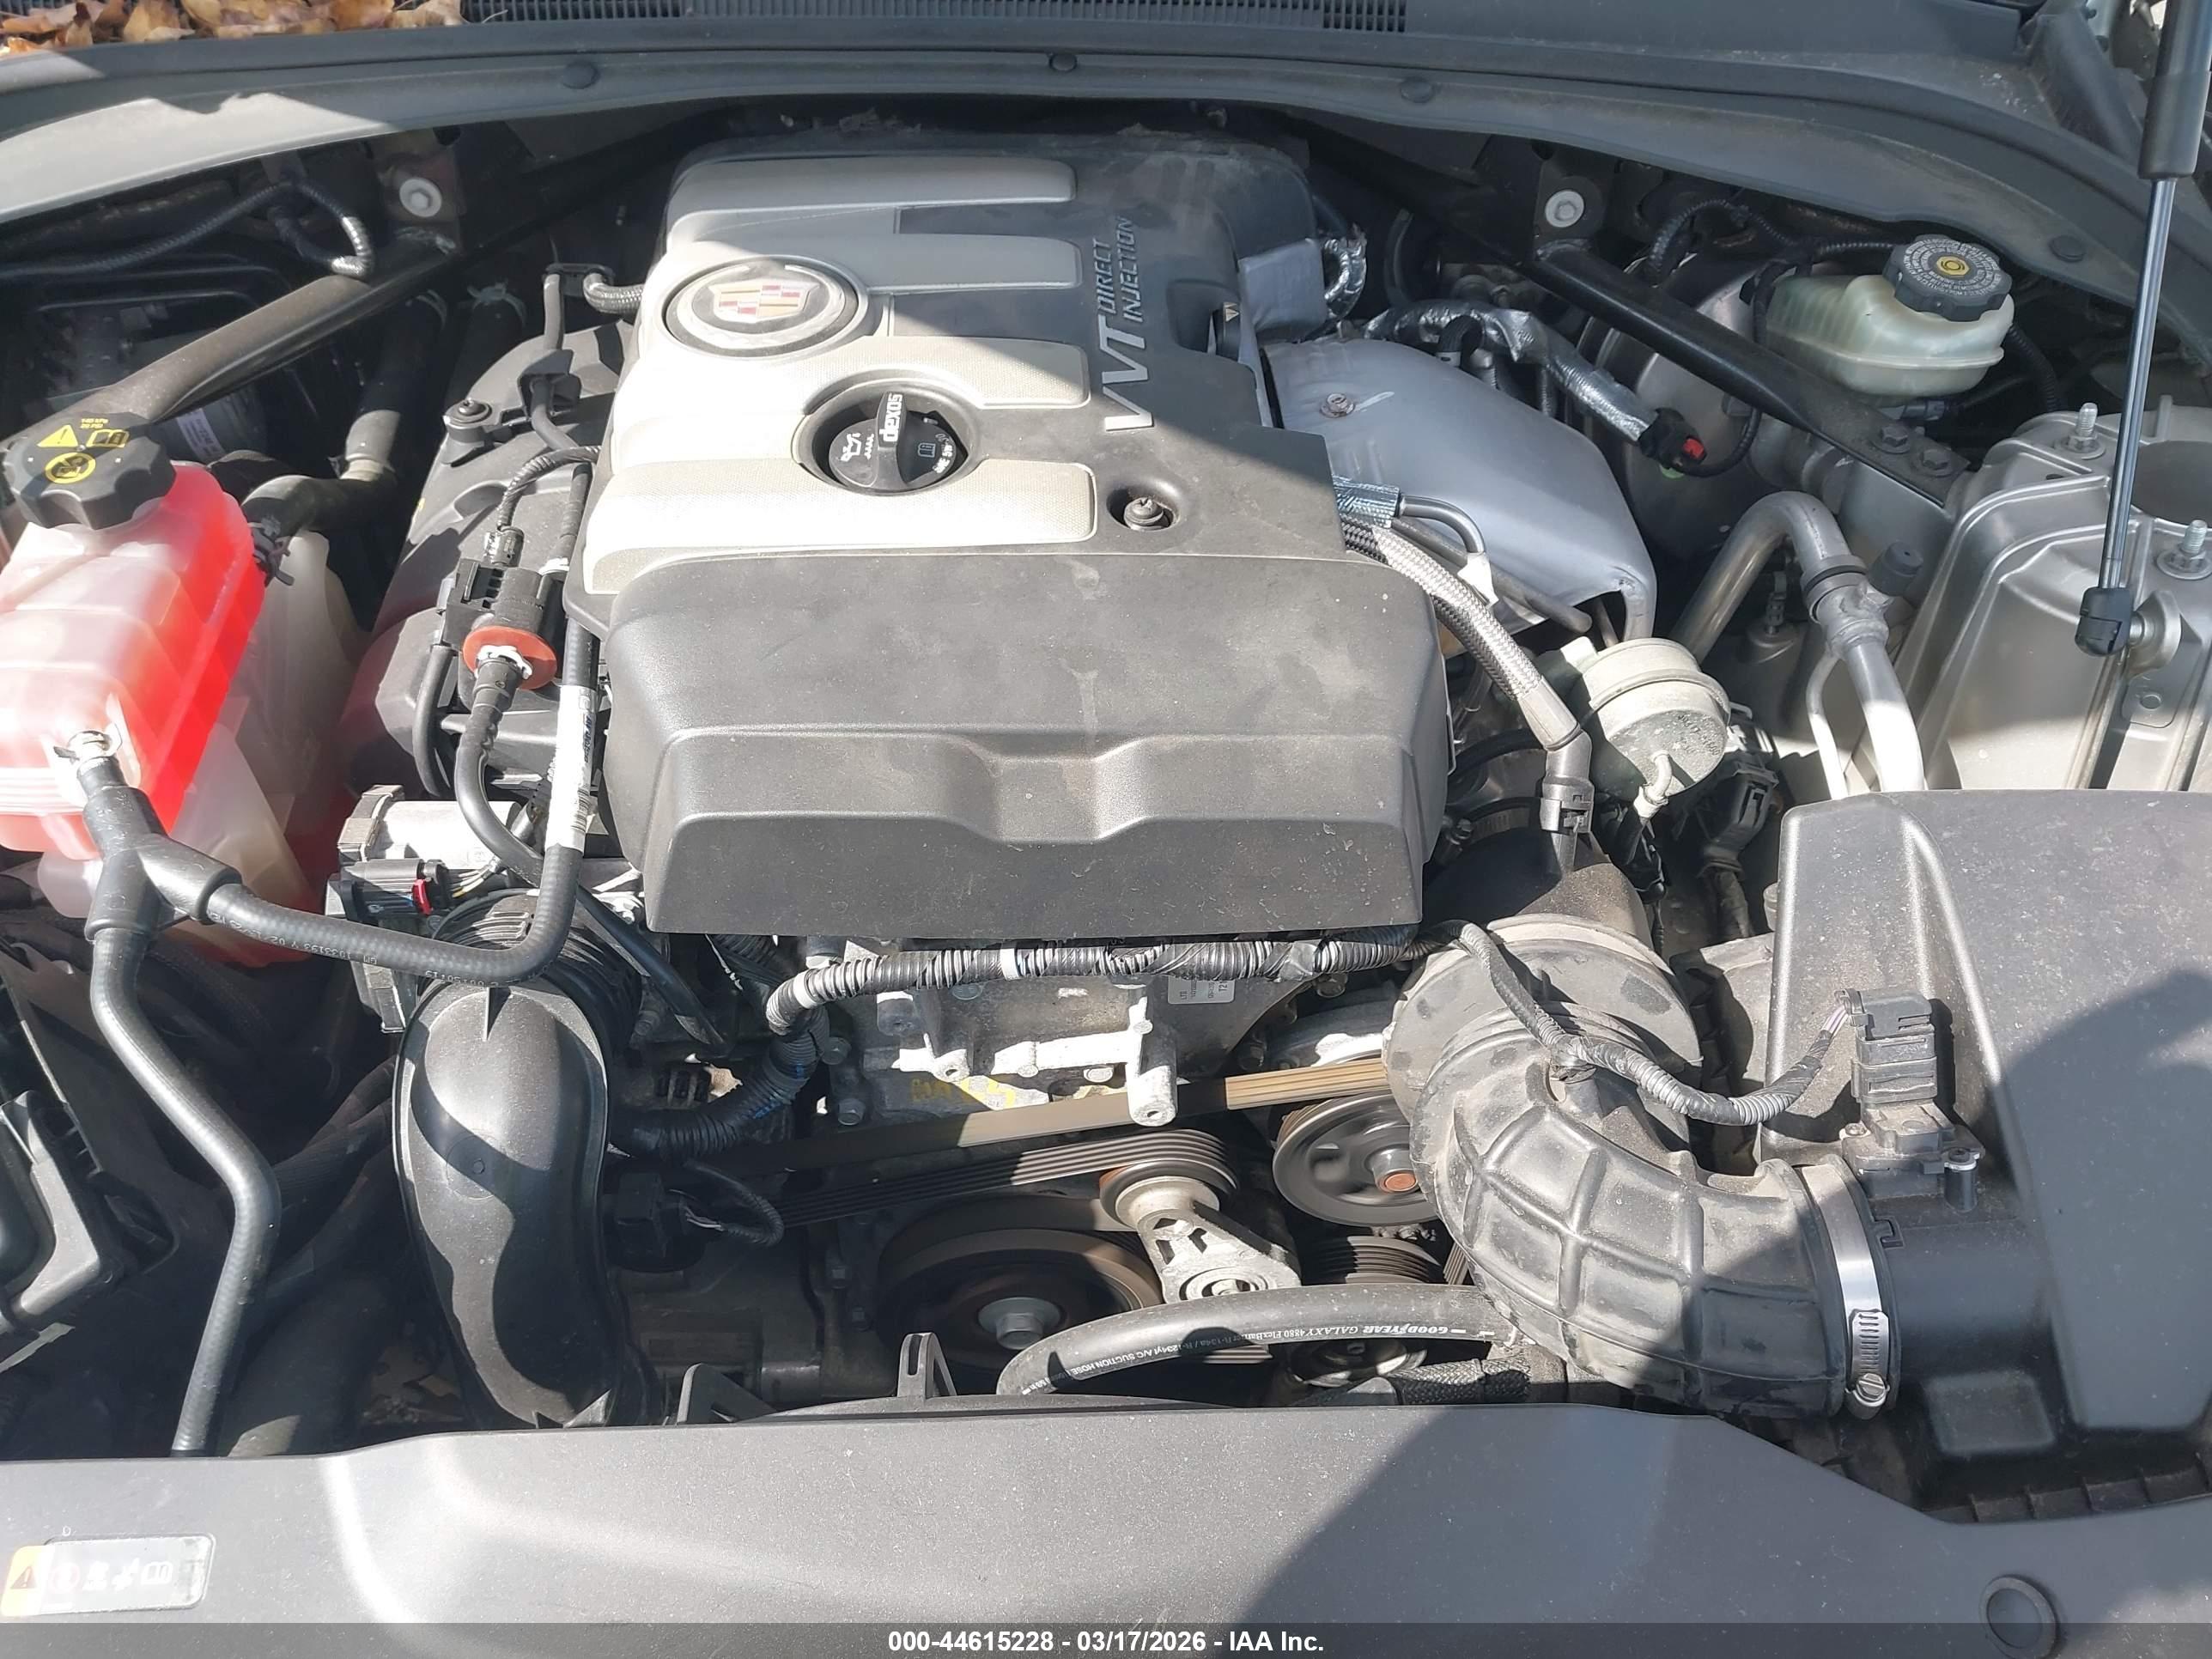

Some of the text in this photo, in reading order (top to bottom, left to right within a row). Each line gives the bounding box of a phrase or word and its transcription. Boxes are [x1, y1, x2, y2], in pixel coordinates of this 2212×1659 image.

[1092, 238, 1116, 314] DIRECT
[1117, 216, 1144, 323] INJECTION
[1098, 314, 1155, 432] VVT
[878, 392, 903, 442] dexos
[1305, 1325, 1358, 1336] GALAXY
[1362, 1323, 1449, 1334] GOODYEAR
[1095, 1353, 1135, 1369] SUCTION
[1137, 1348, 1152, 1358] A/C
[1070, 1363, 1095, 1375] HOSE
